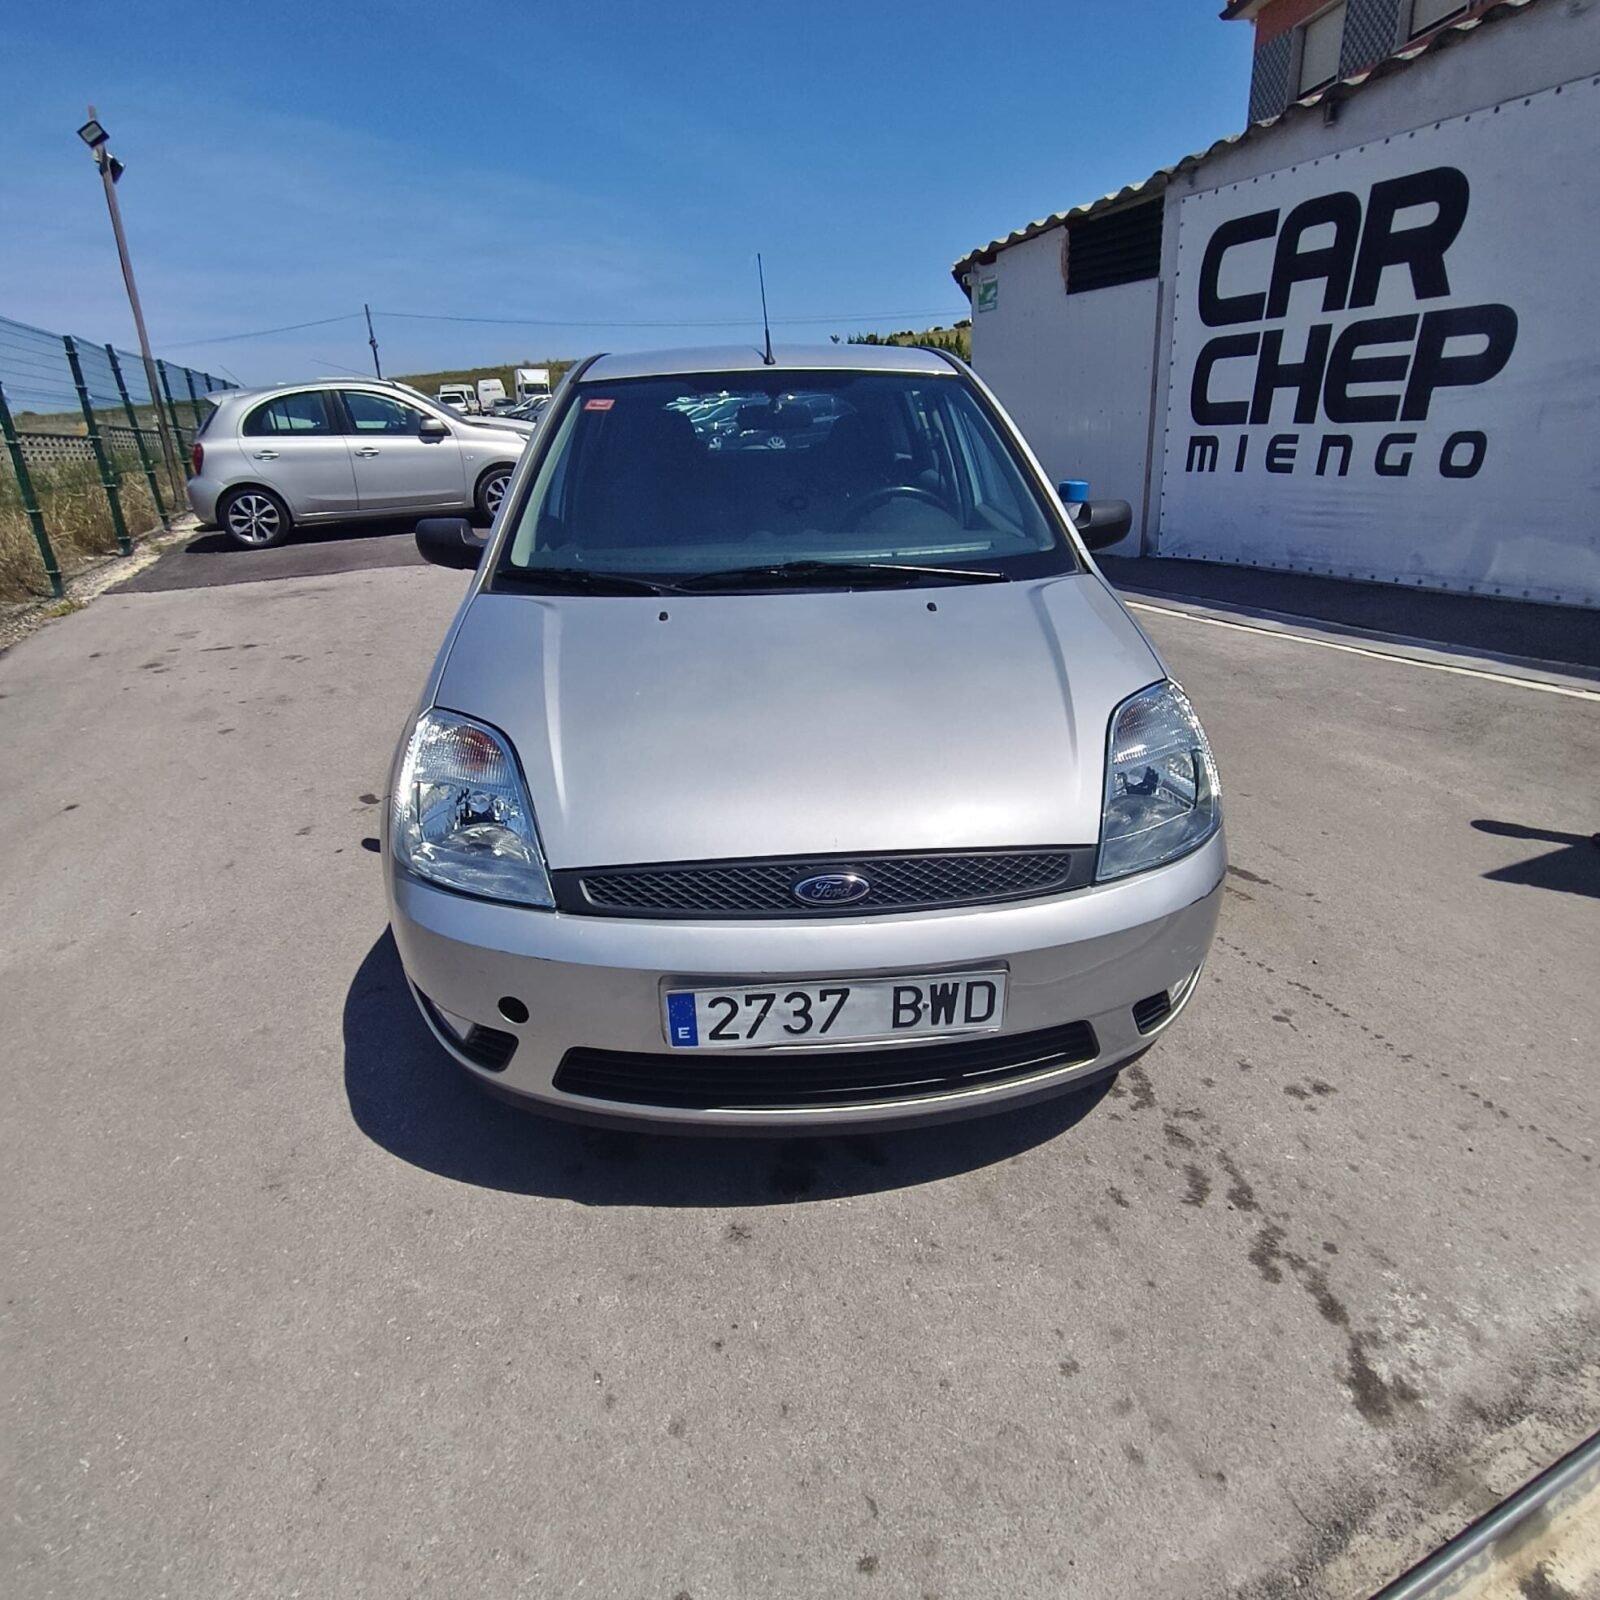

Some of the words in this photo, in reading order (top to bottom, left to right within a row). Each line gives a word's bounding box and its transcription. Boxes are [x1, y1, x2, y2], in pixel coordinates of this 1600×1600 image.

[1198, 166, 1470, 327] CAR
[1190, 303, 1518, 426] CHEP
[1185, 430, 1488, 478] MIENGO
[811, 880, 854, 898] Ford
[678, 1026, 691, 1039] E
[707, 987, 850, 1041] 2737
[892, 980, 997, 1029] BWD
